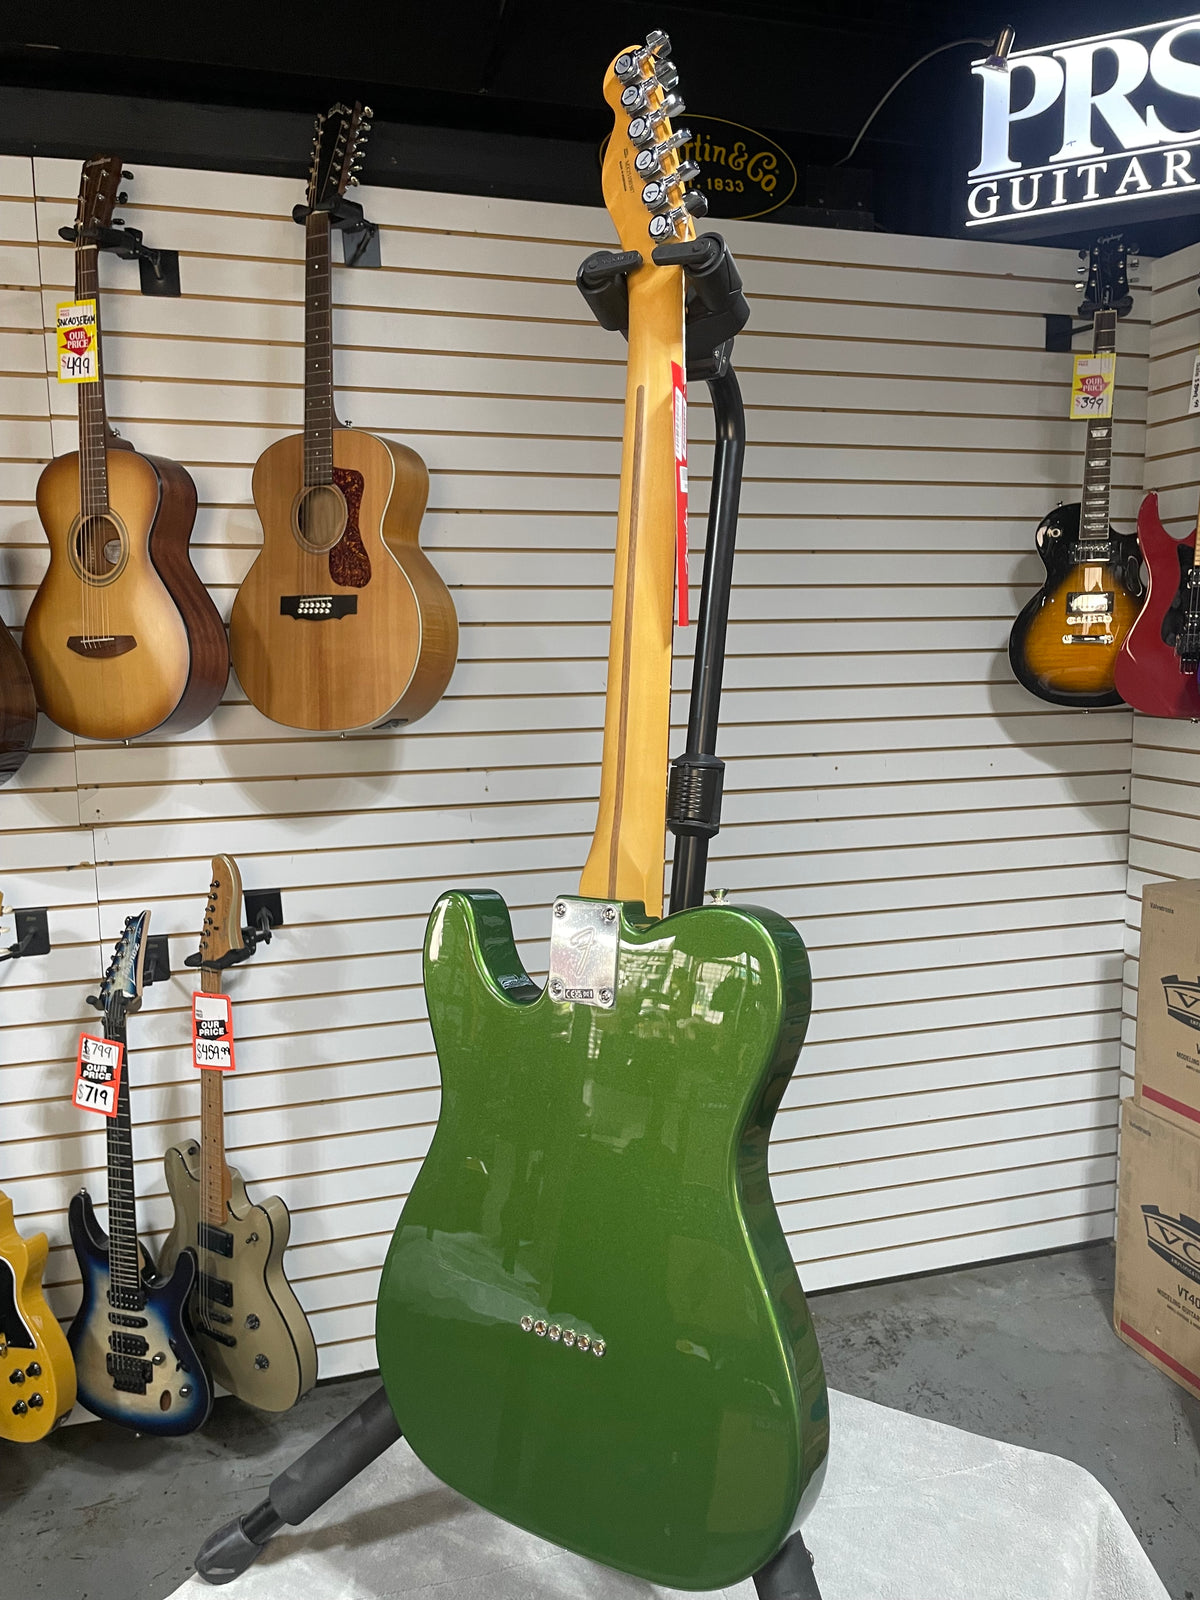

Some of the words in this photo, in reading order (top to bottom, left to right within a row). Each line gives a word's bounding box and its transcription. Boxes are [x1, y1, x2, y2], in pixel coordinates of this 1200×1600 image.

[968, 21, 1200, 178] PRS
[707, 178, 744, 193] 1833
[967, 149, 1196, 218] GUITAR
[69, 331, 86, 341] OUR
[67, 339, 89, 349] PRICE
[61, 356, 90, 376] $499
[1082, 384, 1105, 392] PRICE
[1075, 396, 1104, 409] $399
[201, 1021, 220, 1029] OUR
[199, 1028, 225, 1036] PRICE
[86, 1063, 108, 1073] OUR
[82, 1069, 112, 1080] PRICE
[77, 1083, 108, 1106] $719
